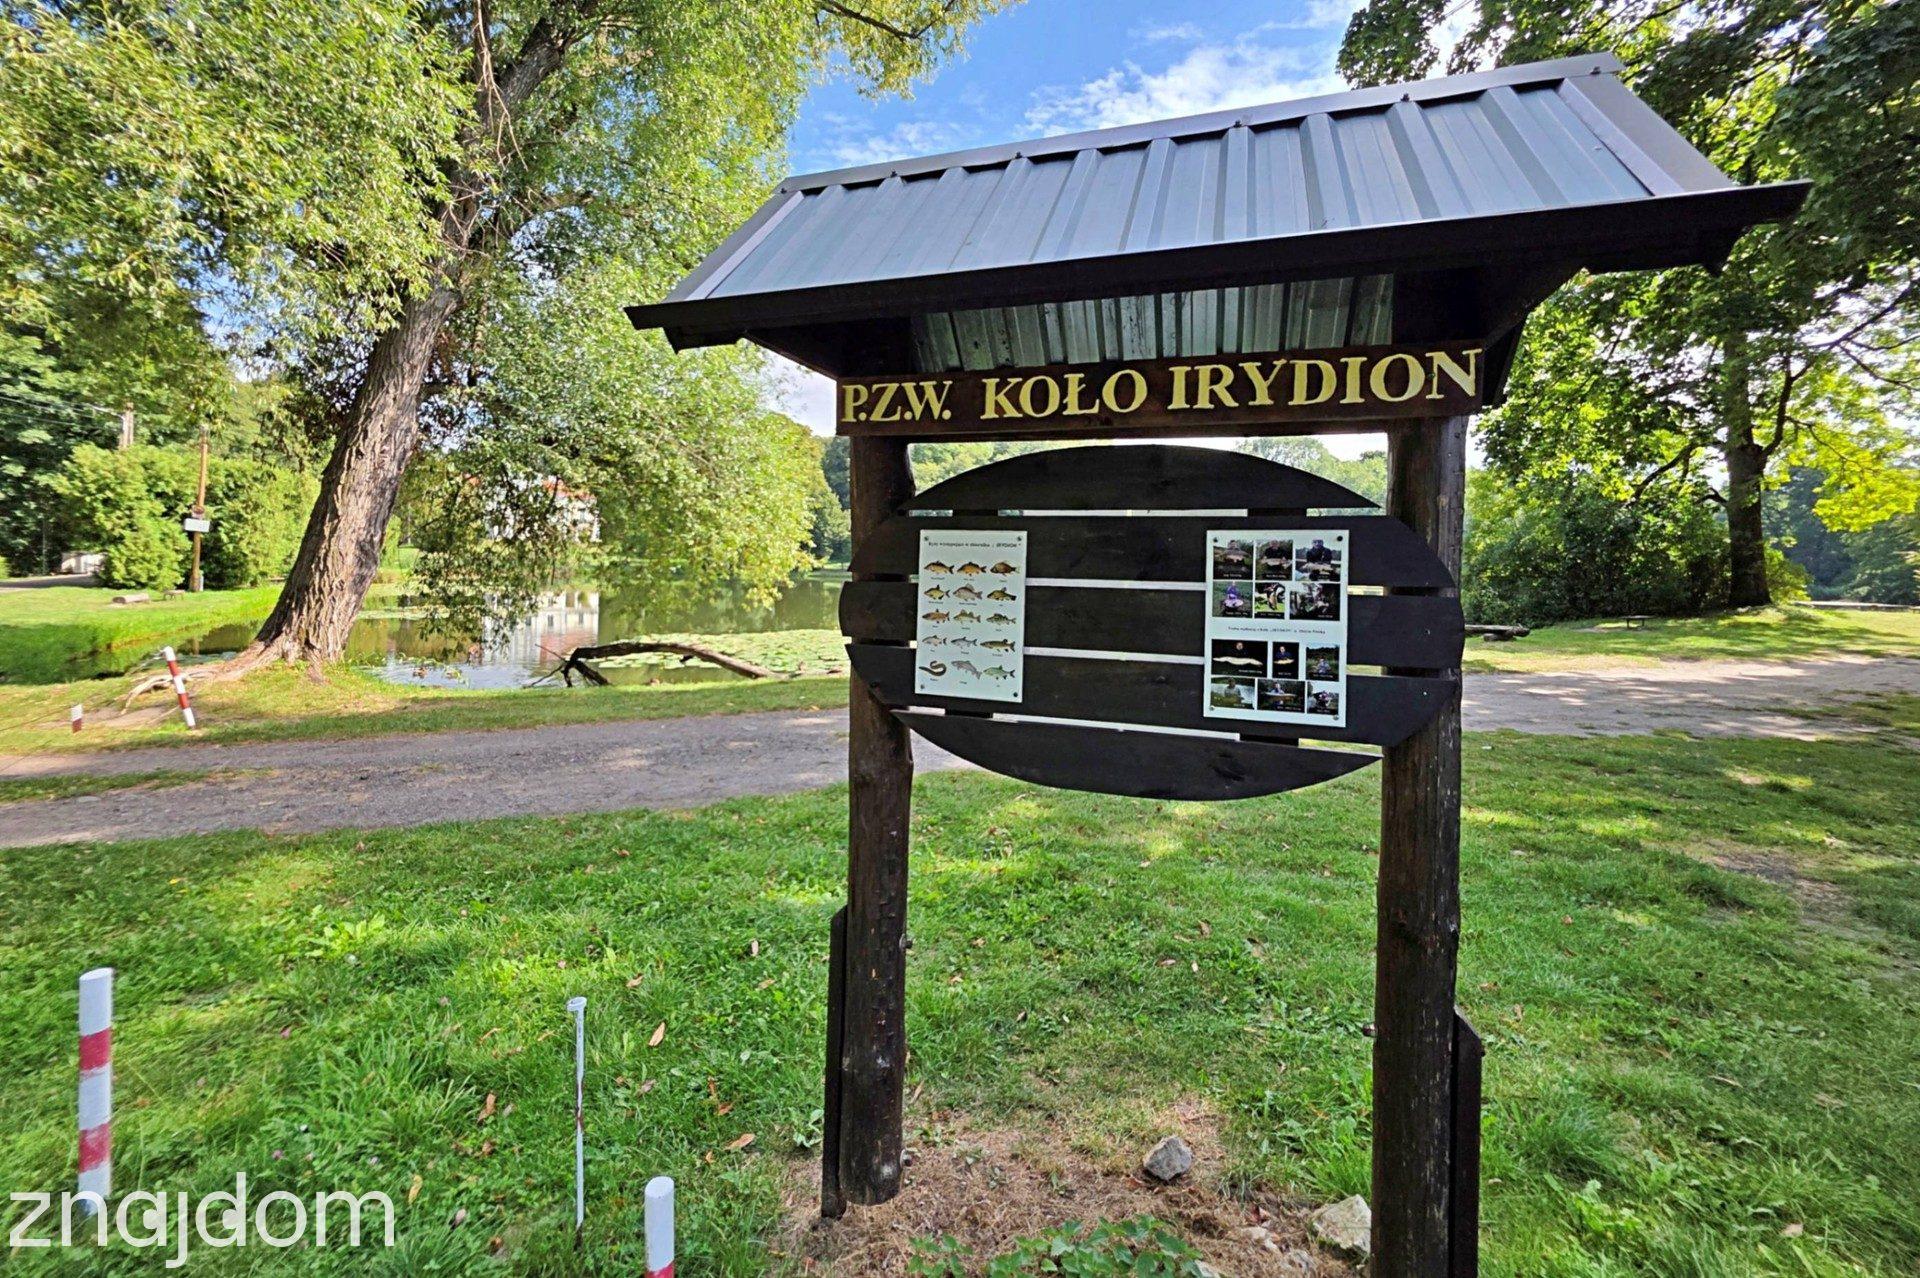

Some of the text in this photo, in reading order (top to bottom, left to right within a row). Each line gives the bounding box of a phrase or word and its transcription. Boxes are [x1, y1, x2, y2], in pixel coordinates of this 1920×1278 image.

[841, 348, 1483, 422] P.Z.W. KOŁO IRYDION
